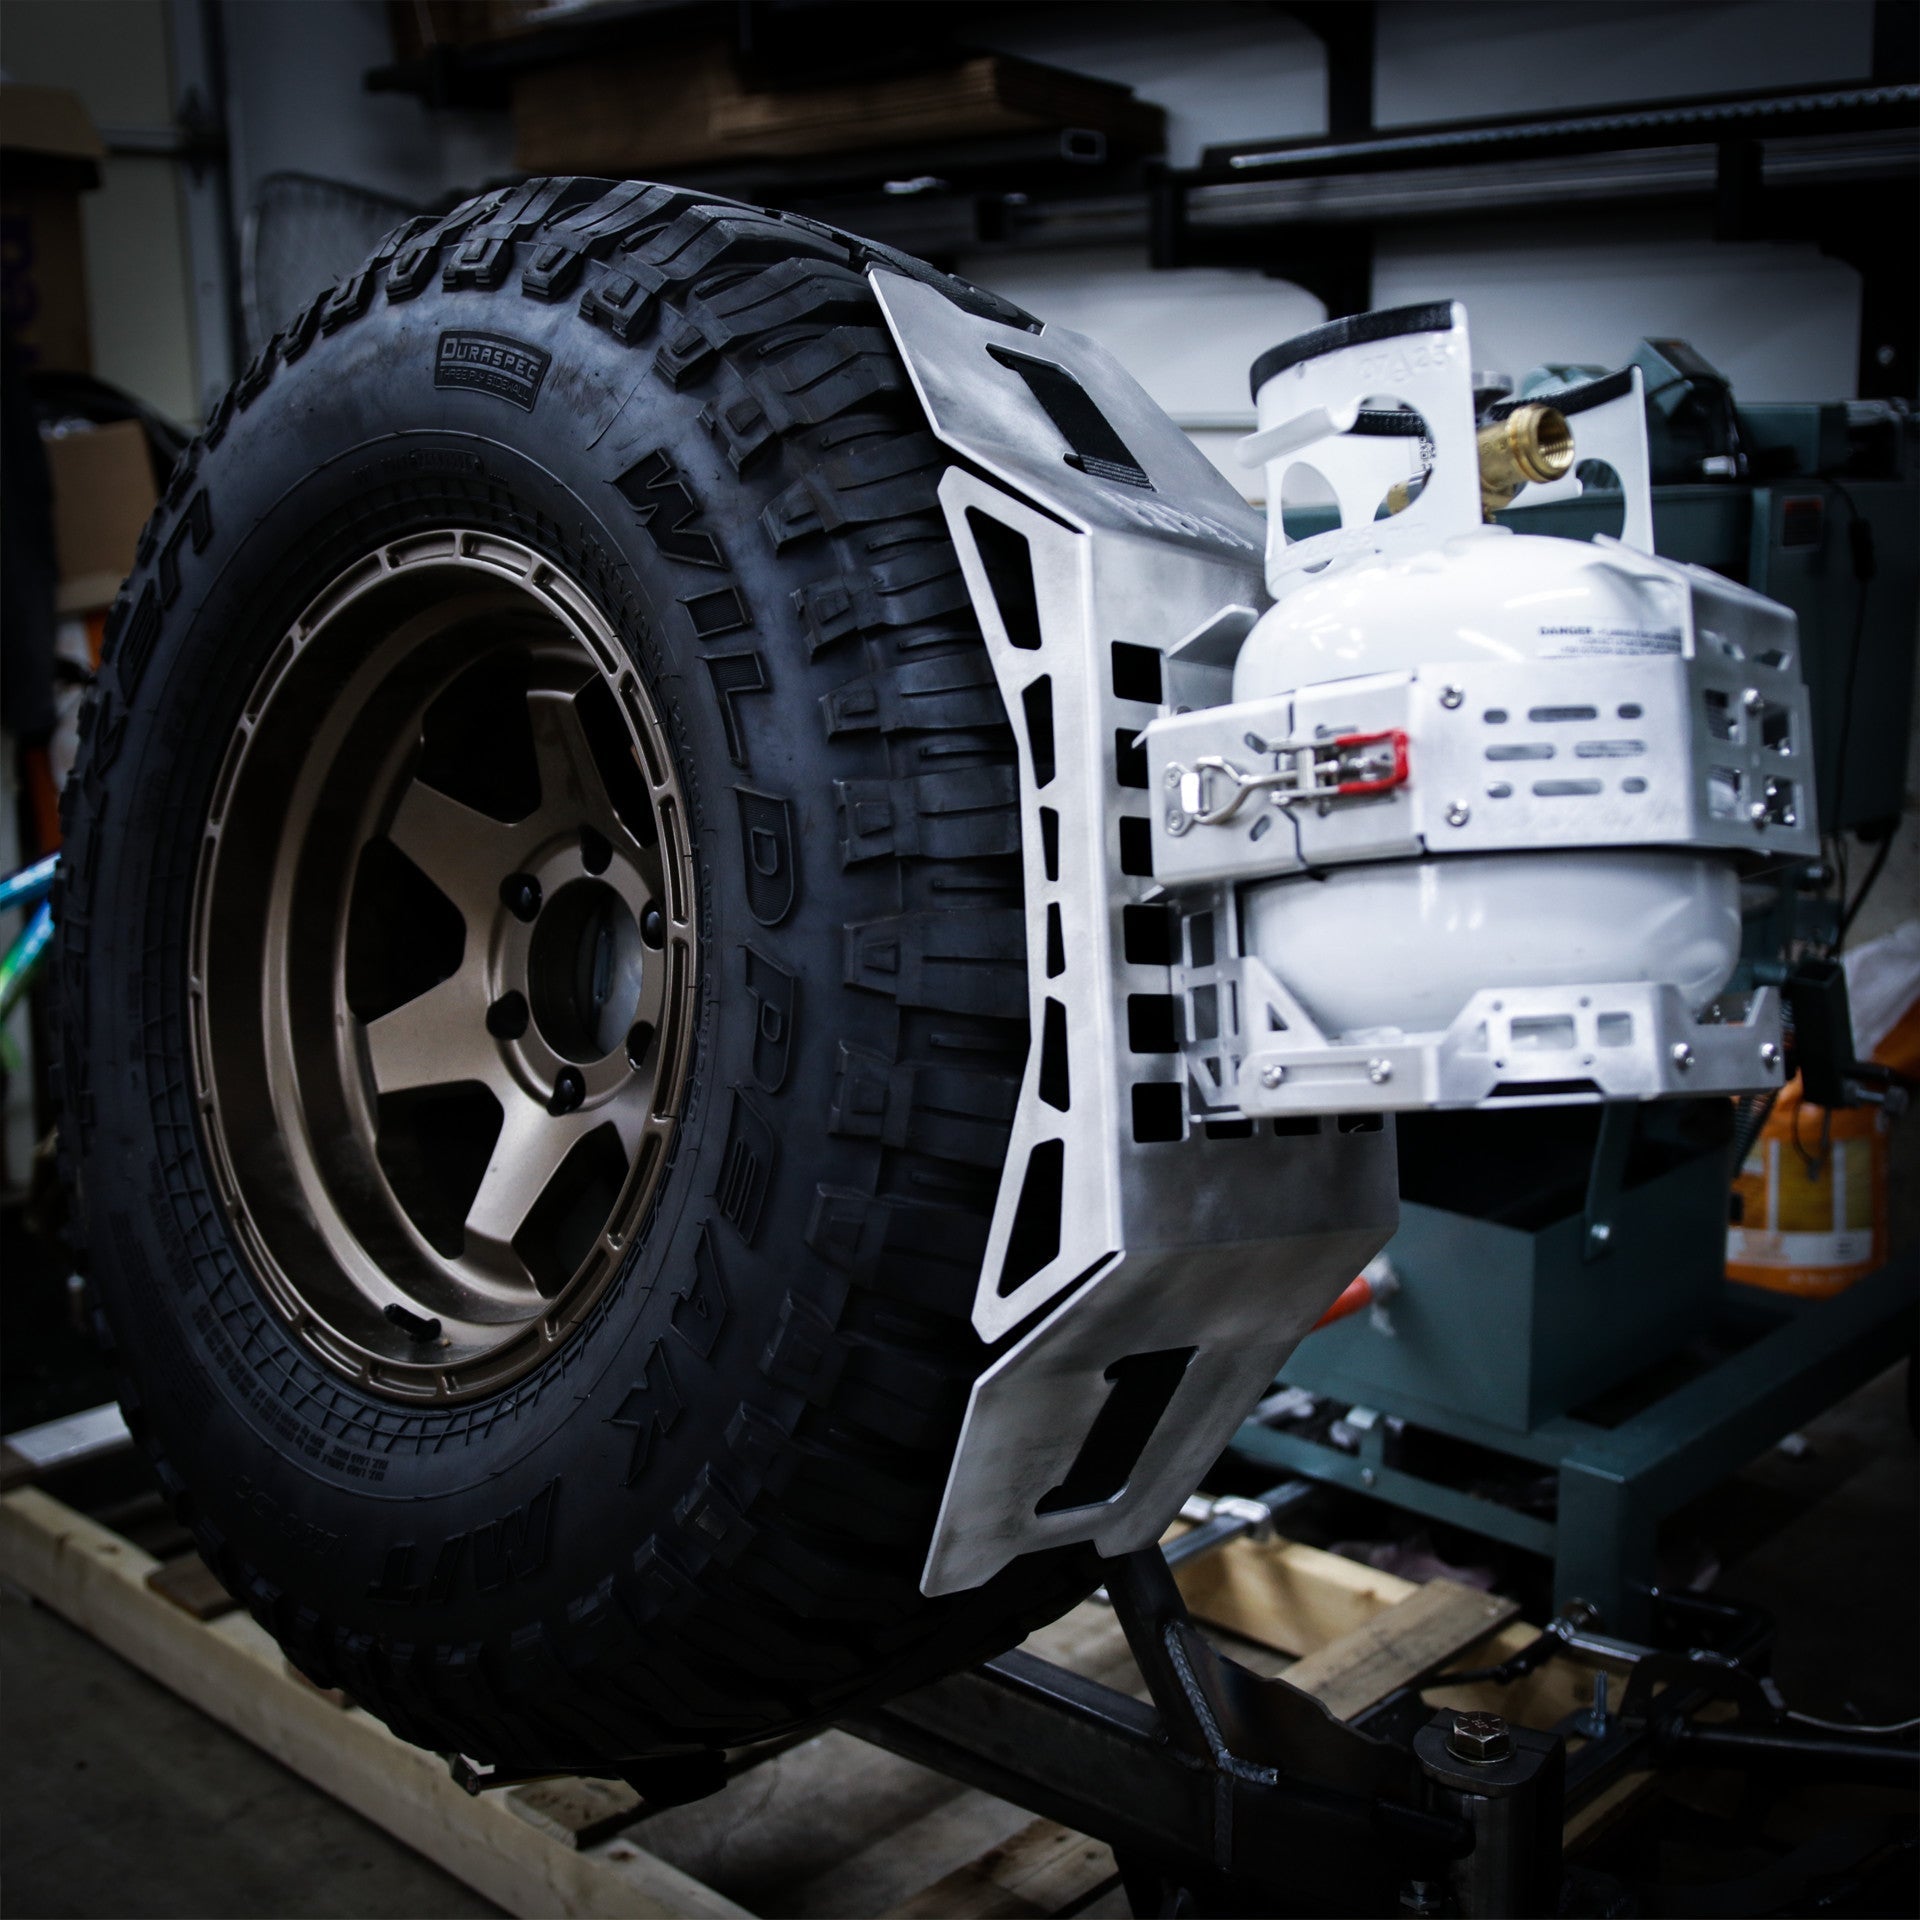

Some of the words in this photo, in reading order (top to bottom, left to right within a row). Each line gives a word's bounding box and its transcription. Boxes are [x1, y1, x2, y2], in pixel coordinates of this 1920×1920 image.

[441, 337, 540, 380] DURASPEC
[604, 447, 798, 1489] WILDPEAK
[365, 1473, 562, 1607] M/T
